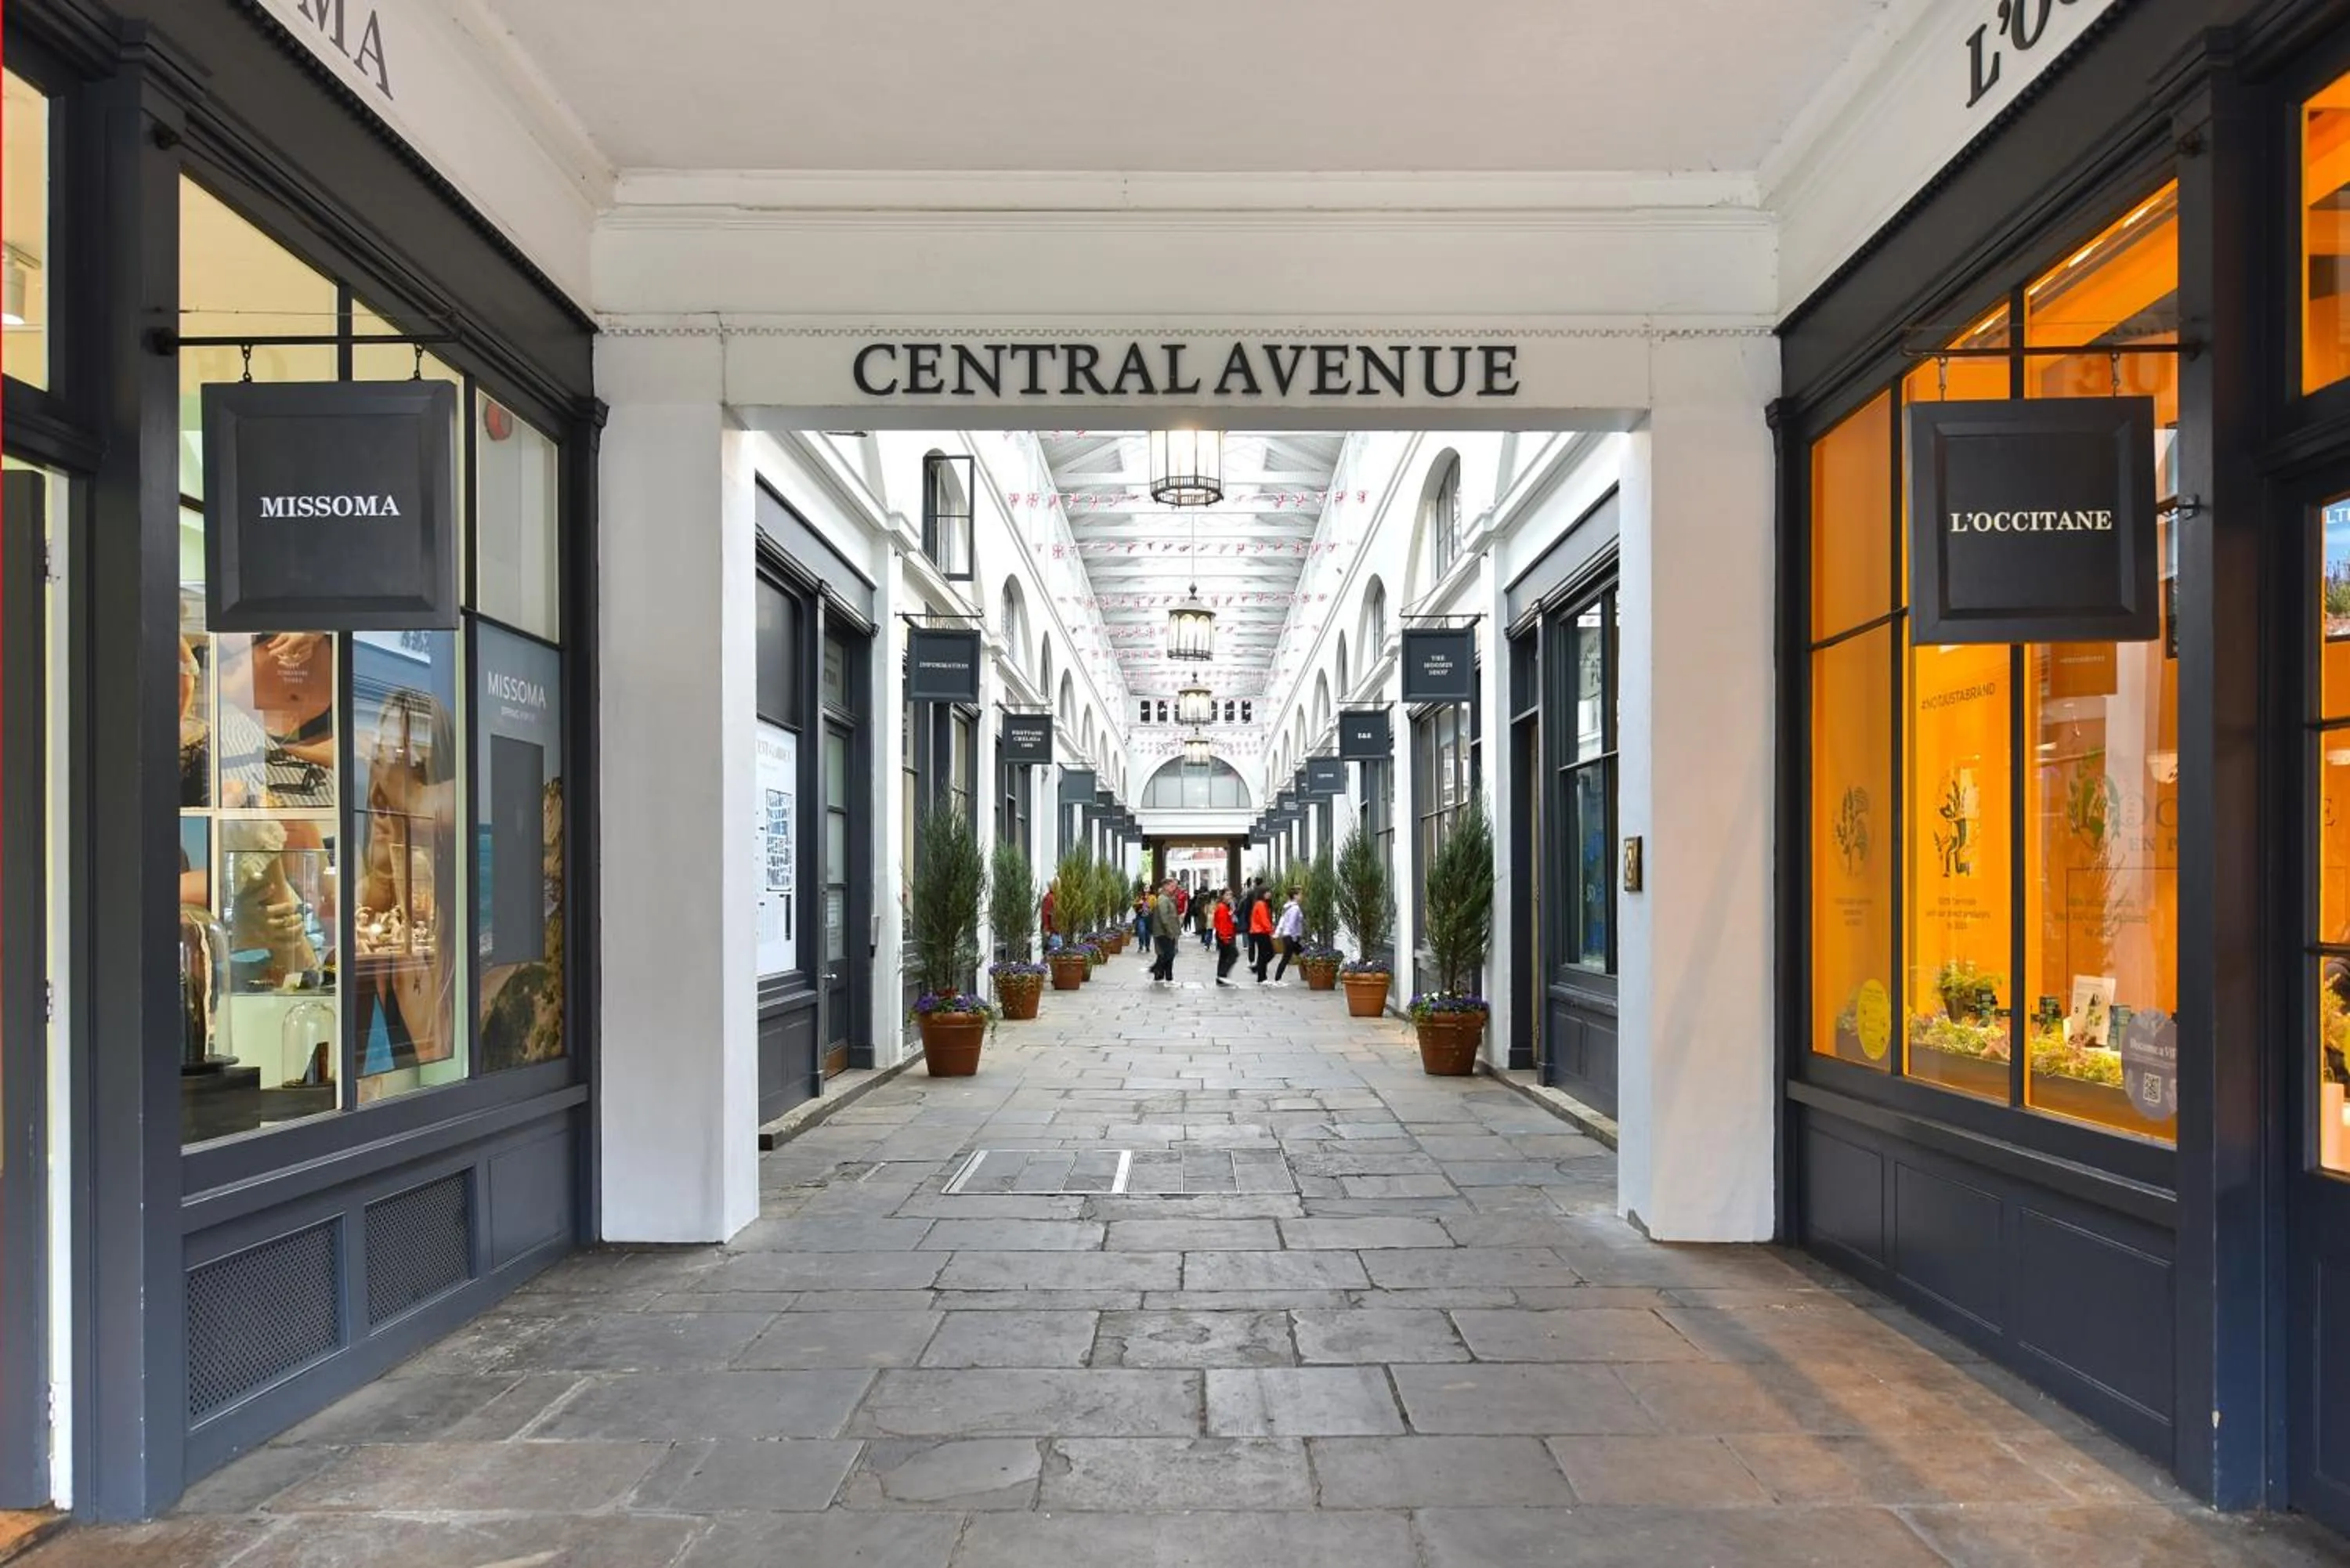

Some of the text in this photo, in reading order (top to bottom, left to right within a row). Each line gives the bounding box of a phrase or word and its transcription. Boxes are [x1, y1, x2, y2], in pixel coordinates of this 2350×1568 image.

[852, 341, 1520, 398] CENTRAL AVENUE
[259, 494, 401, 518] MISSOMA
[487, 670, 547, 710] MISSOMA
